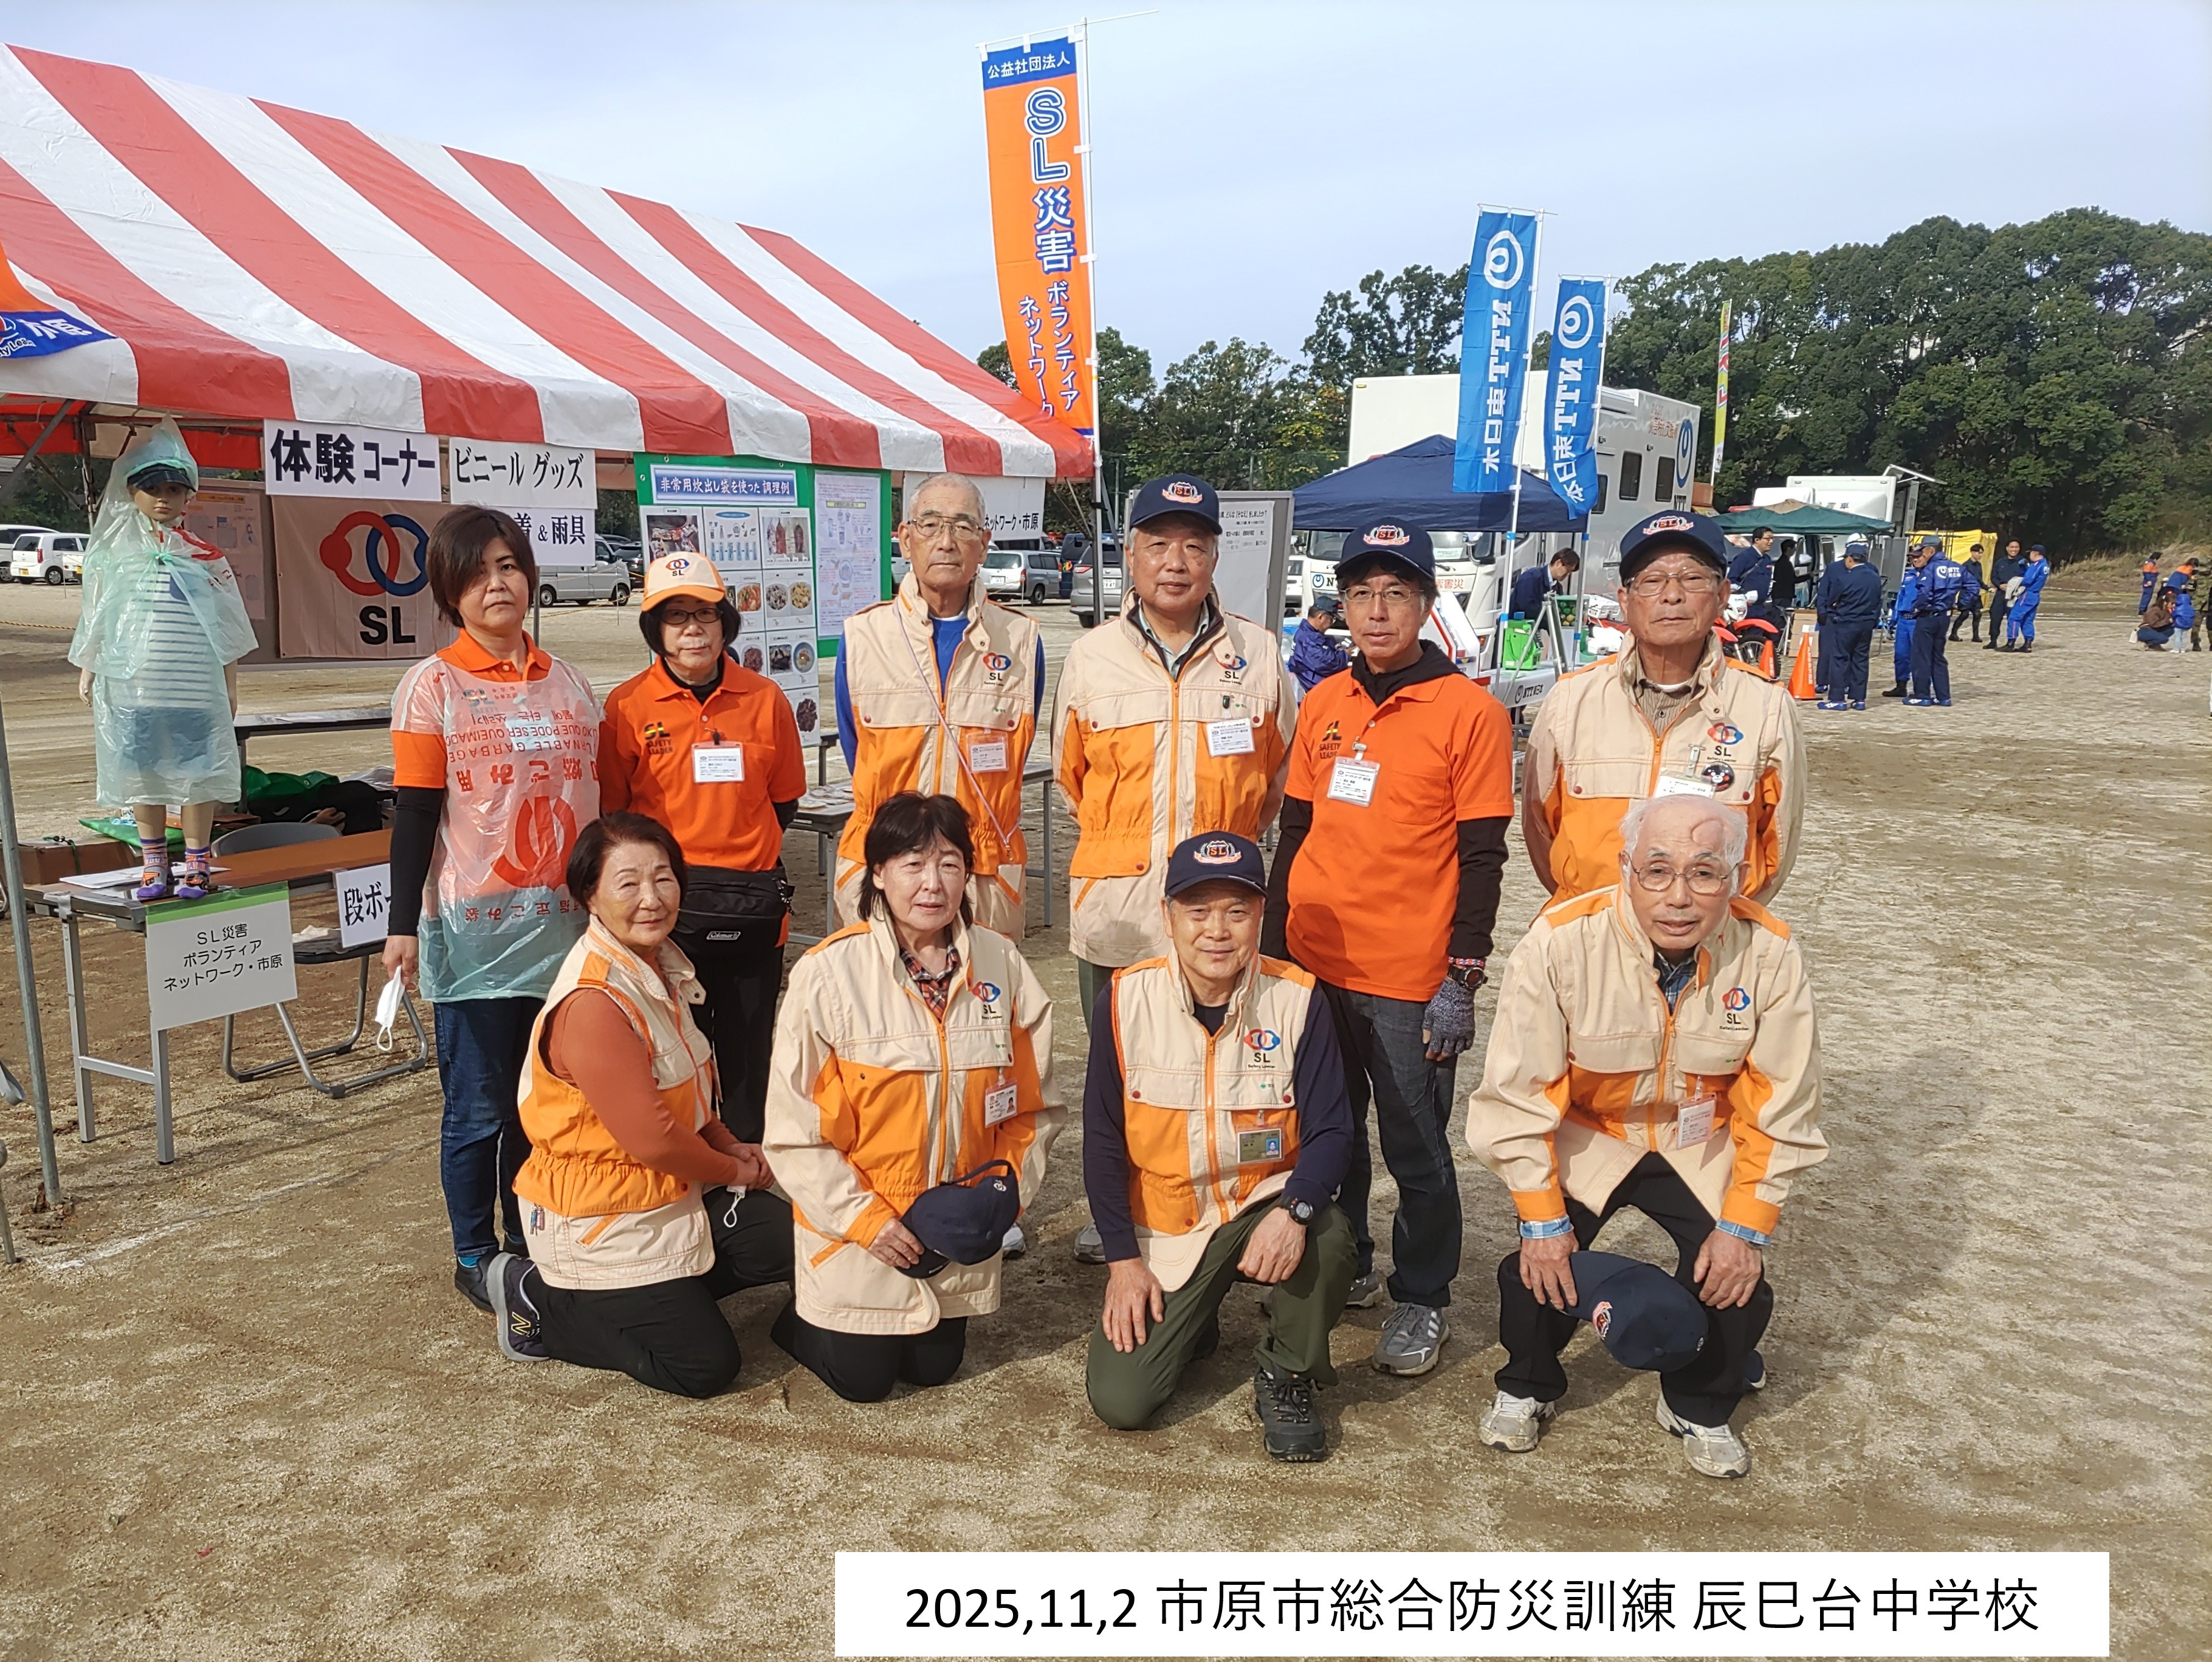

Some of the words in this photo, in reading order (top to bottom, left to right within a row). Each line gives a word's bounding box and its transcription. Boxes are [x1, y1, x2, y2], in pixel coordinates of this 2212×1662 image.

[987, 51, 1070, 79] 公益社団法人
[1019, 296, 1054, 416] ネットワーク
[1047, 280, 1080, 410] ボランティア
[270, 428, 436, 487] 体験コーナー
[455, 446, 524, 487] ビニール
[533, 451, 584, 489] グッズ
[551, 515, 585, 545] 雨具
[984, 513, 1039, 531] ネットワーク・市原
[360, 605, 416, 645] SL
[989, 672, 1003, 681] SL
[1224, 670, 1240, 679] SL
[448, 741, 526, 763] GARBAGE
[1319, 743, 1342, 751] SAFETY
[1714, 746, 1732, 757] SL
[1210, 847, 1226, 856] SL
[344, 881, 391, 927] 段ボ
[197, 923, 248, 945] SL災害
[184, 939, 262, 967] ボランティア
[164, 954, 283, 991] ネットワーク・市原
[983, 1004, 997, 1014] SL
[1726, 1012, 1742, 1025] SL
[1254, 1052, 1271, 1062] SL
